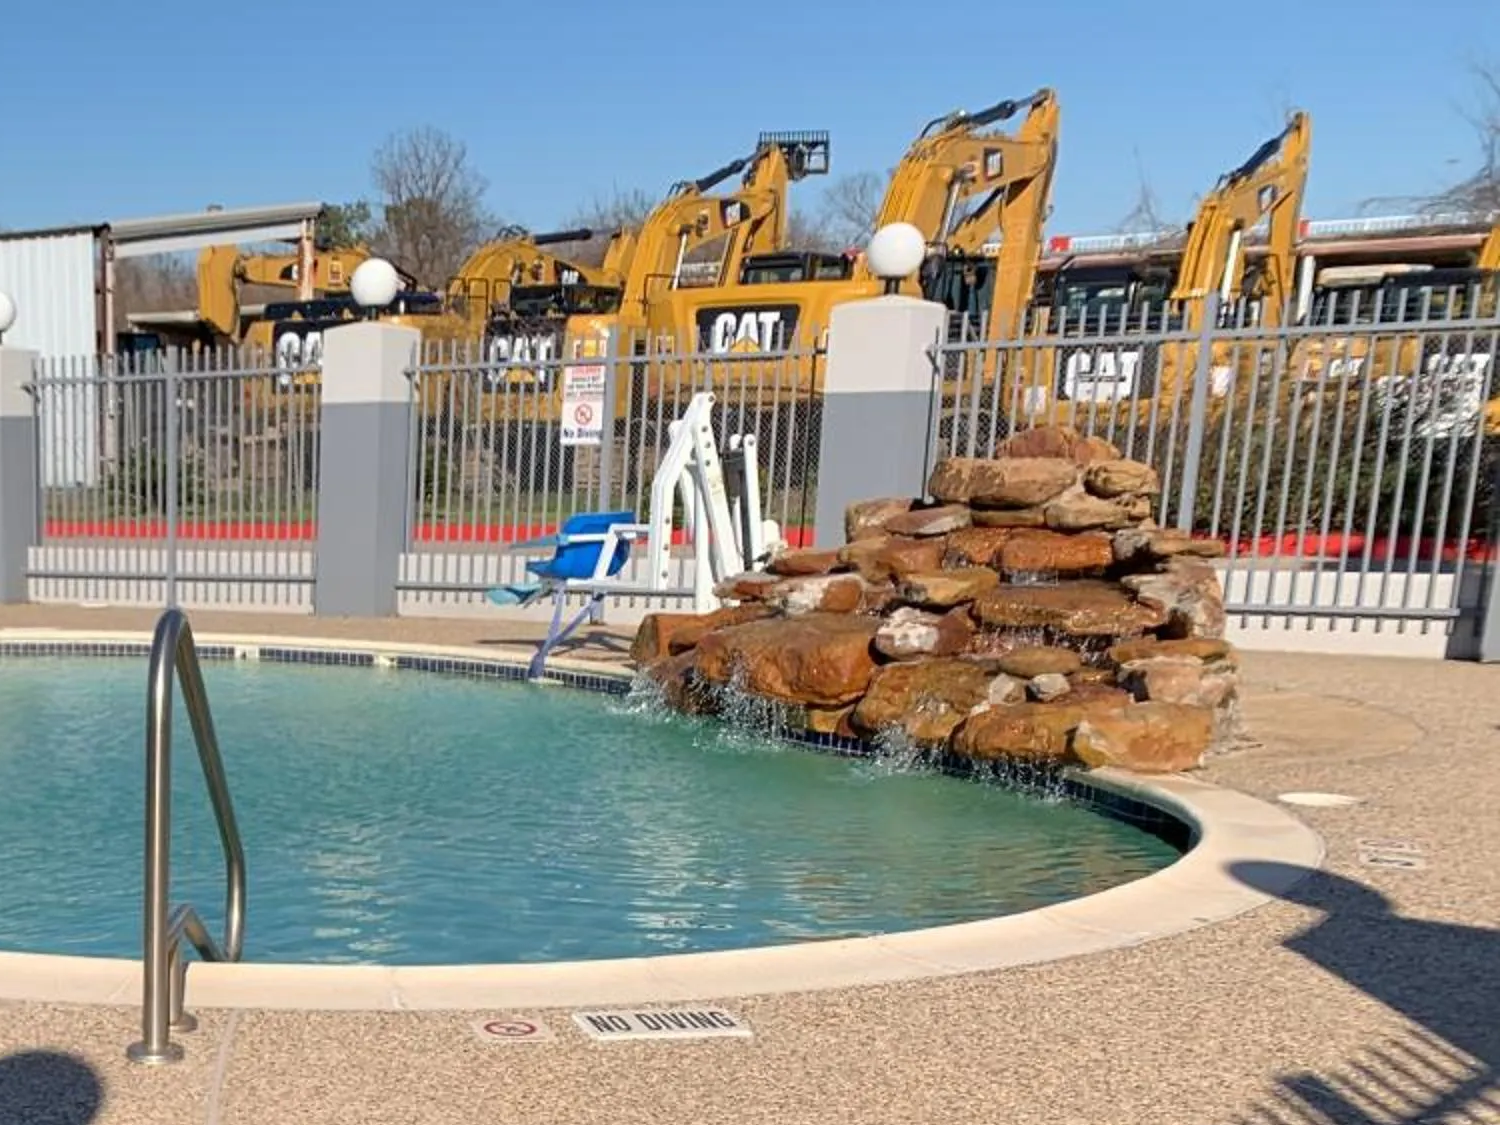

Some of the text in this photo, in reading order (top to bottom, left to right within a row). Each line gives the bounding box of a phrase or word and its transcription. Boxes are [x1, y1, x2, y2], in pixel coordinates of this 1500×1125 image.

[714, 311, 781, 354] CAT
[278, 331, 322, 385] CA
[488, 334, 556, 385] CAT
[1064, 351, 1141, 402] CAT
[563, 427, 575, 438] No
[586, 1011, 737, 1032] NO DIVING
